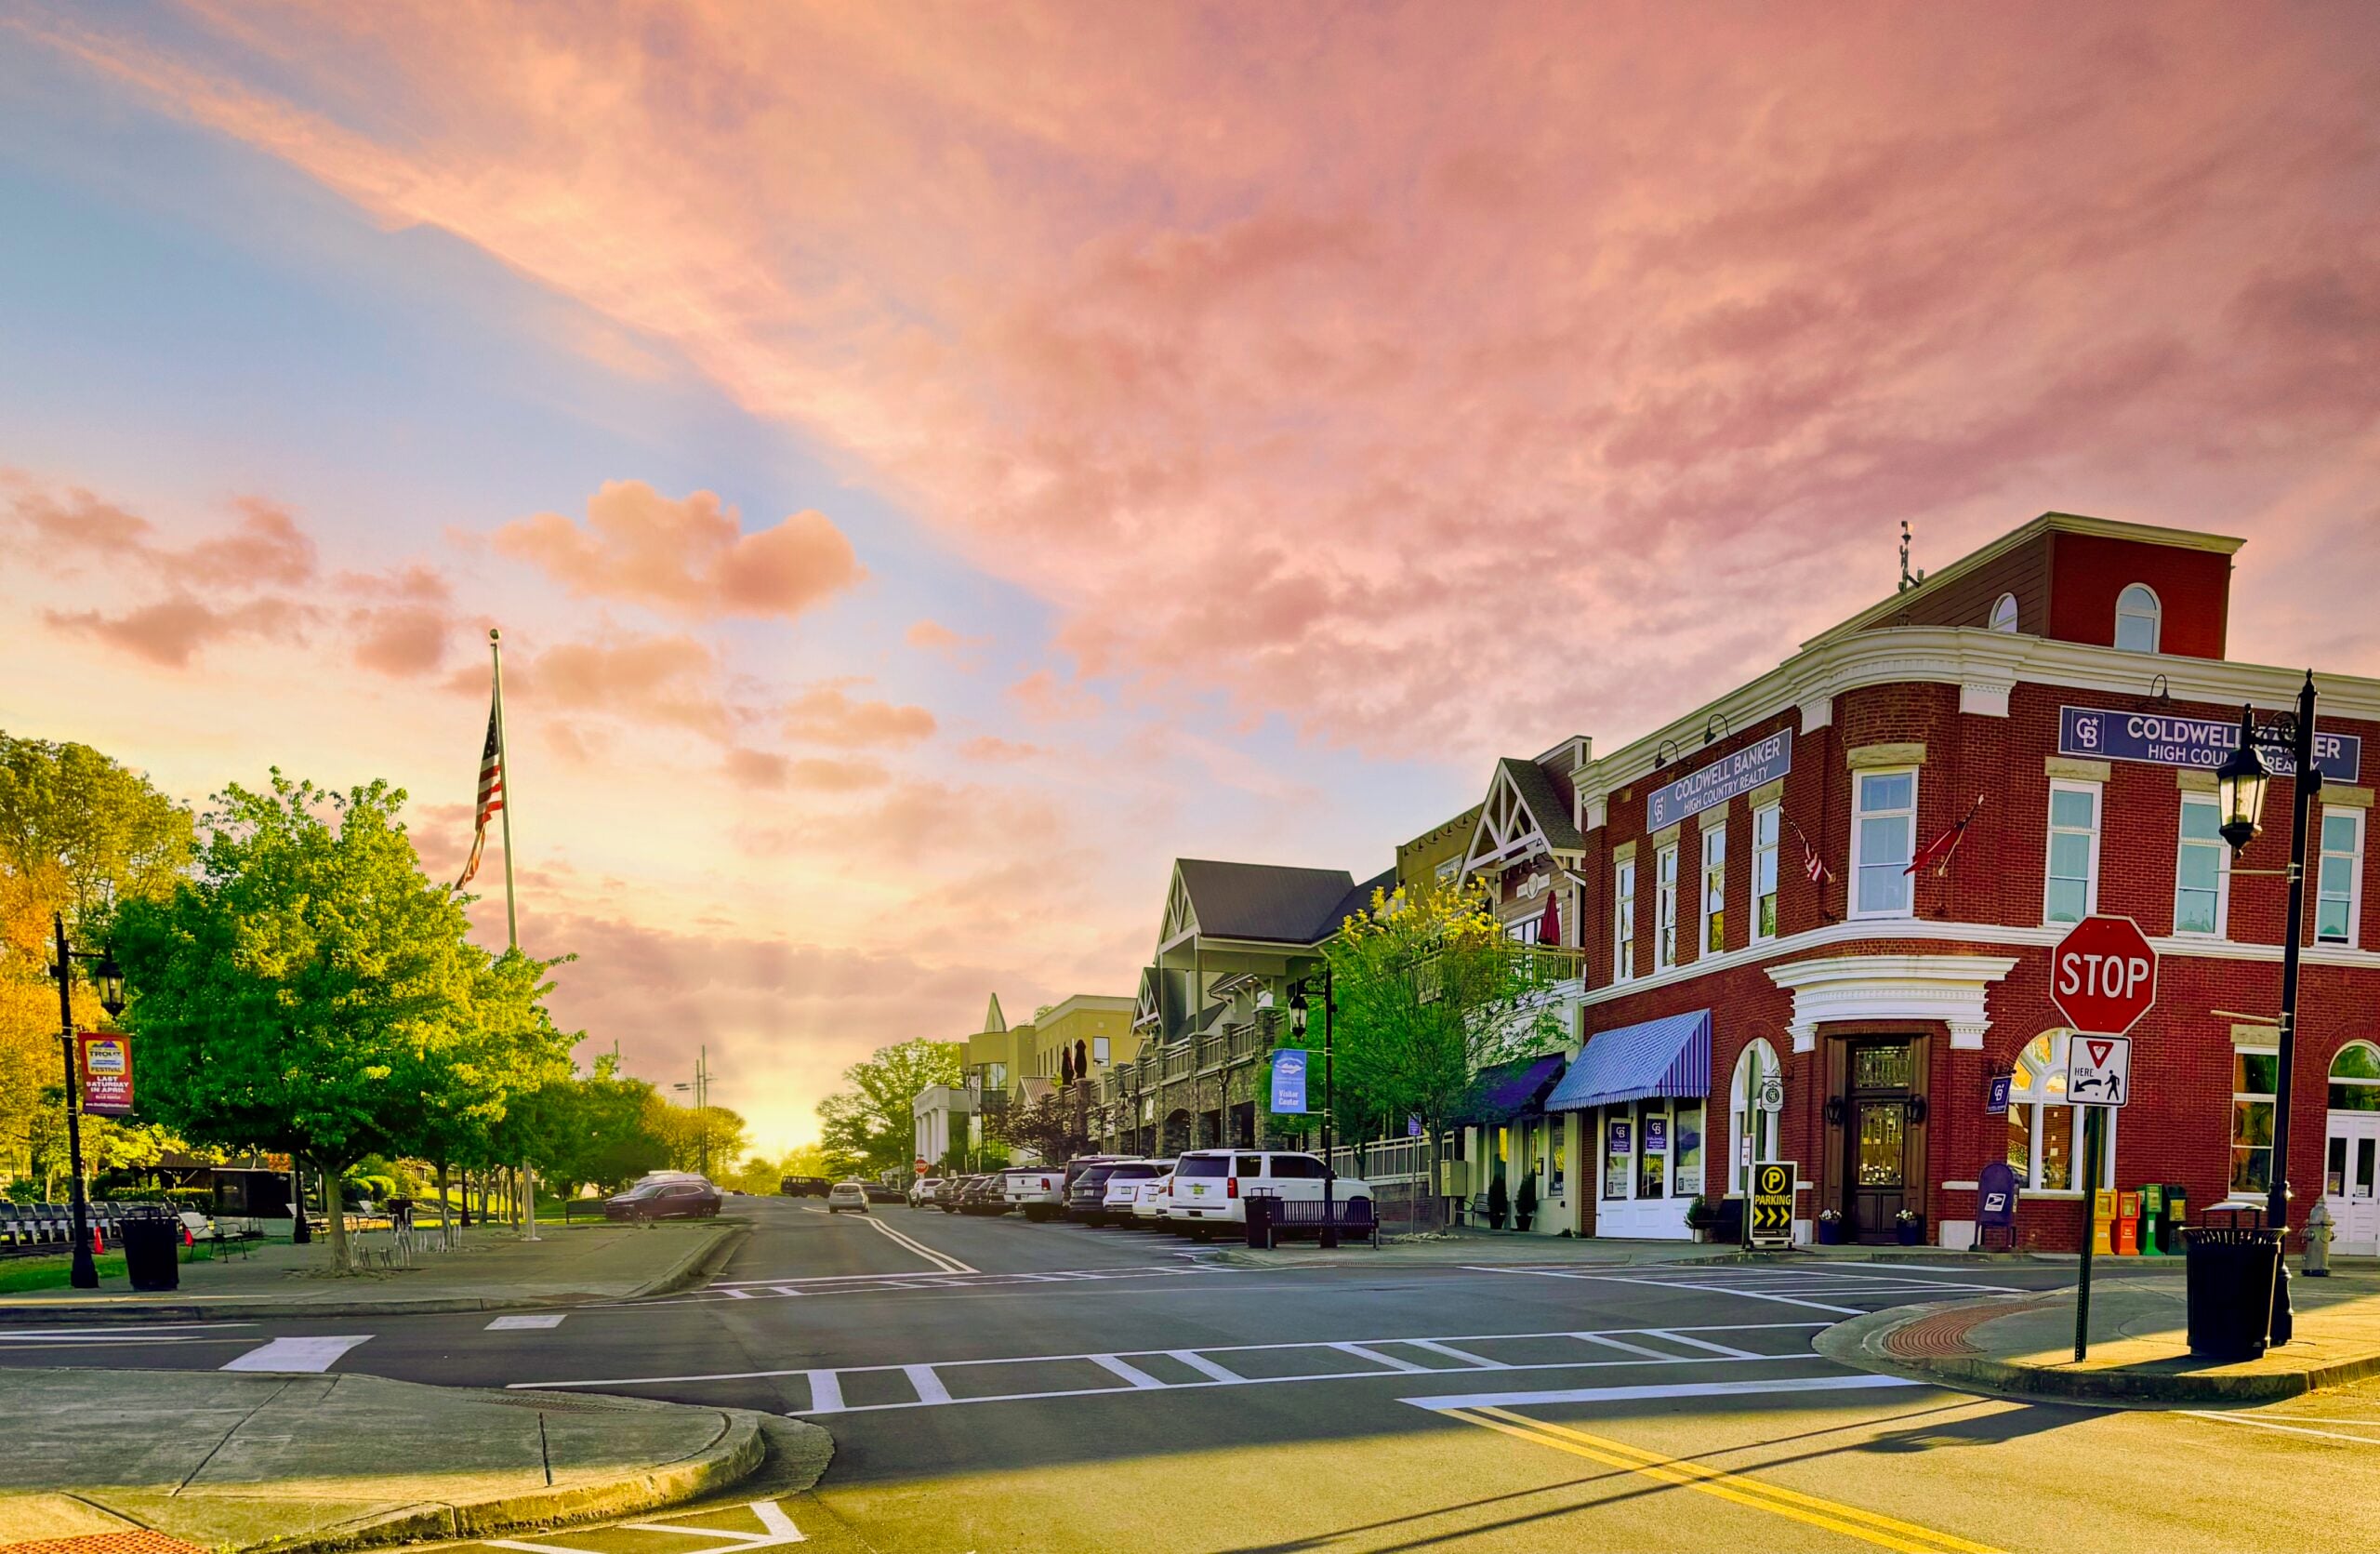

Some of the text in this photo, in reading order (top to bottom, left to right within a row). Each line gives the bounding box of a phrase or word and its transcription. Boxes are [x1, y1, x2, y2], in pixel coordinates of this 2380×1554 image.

[2127, 716, 2241, 749] COLDWELL
[2149, 744, 2186, 761] HIGH
[1675, 737, 1780, 801] COLDWELL BANKER
[1685, 765, 1769, 814] HIGH COUNTRY REALTY
[2059, 952, 2149, 999] STOP
[2074, 1067, 2094, 1077] HERE
[1279, 1090, 1299, 1098] Visitor
[1769, 1172, 1780, 1189] P
[1754, 1194, 1792, 1206] PARKING
